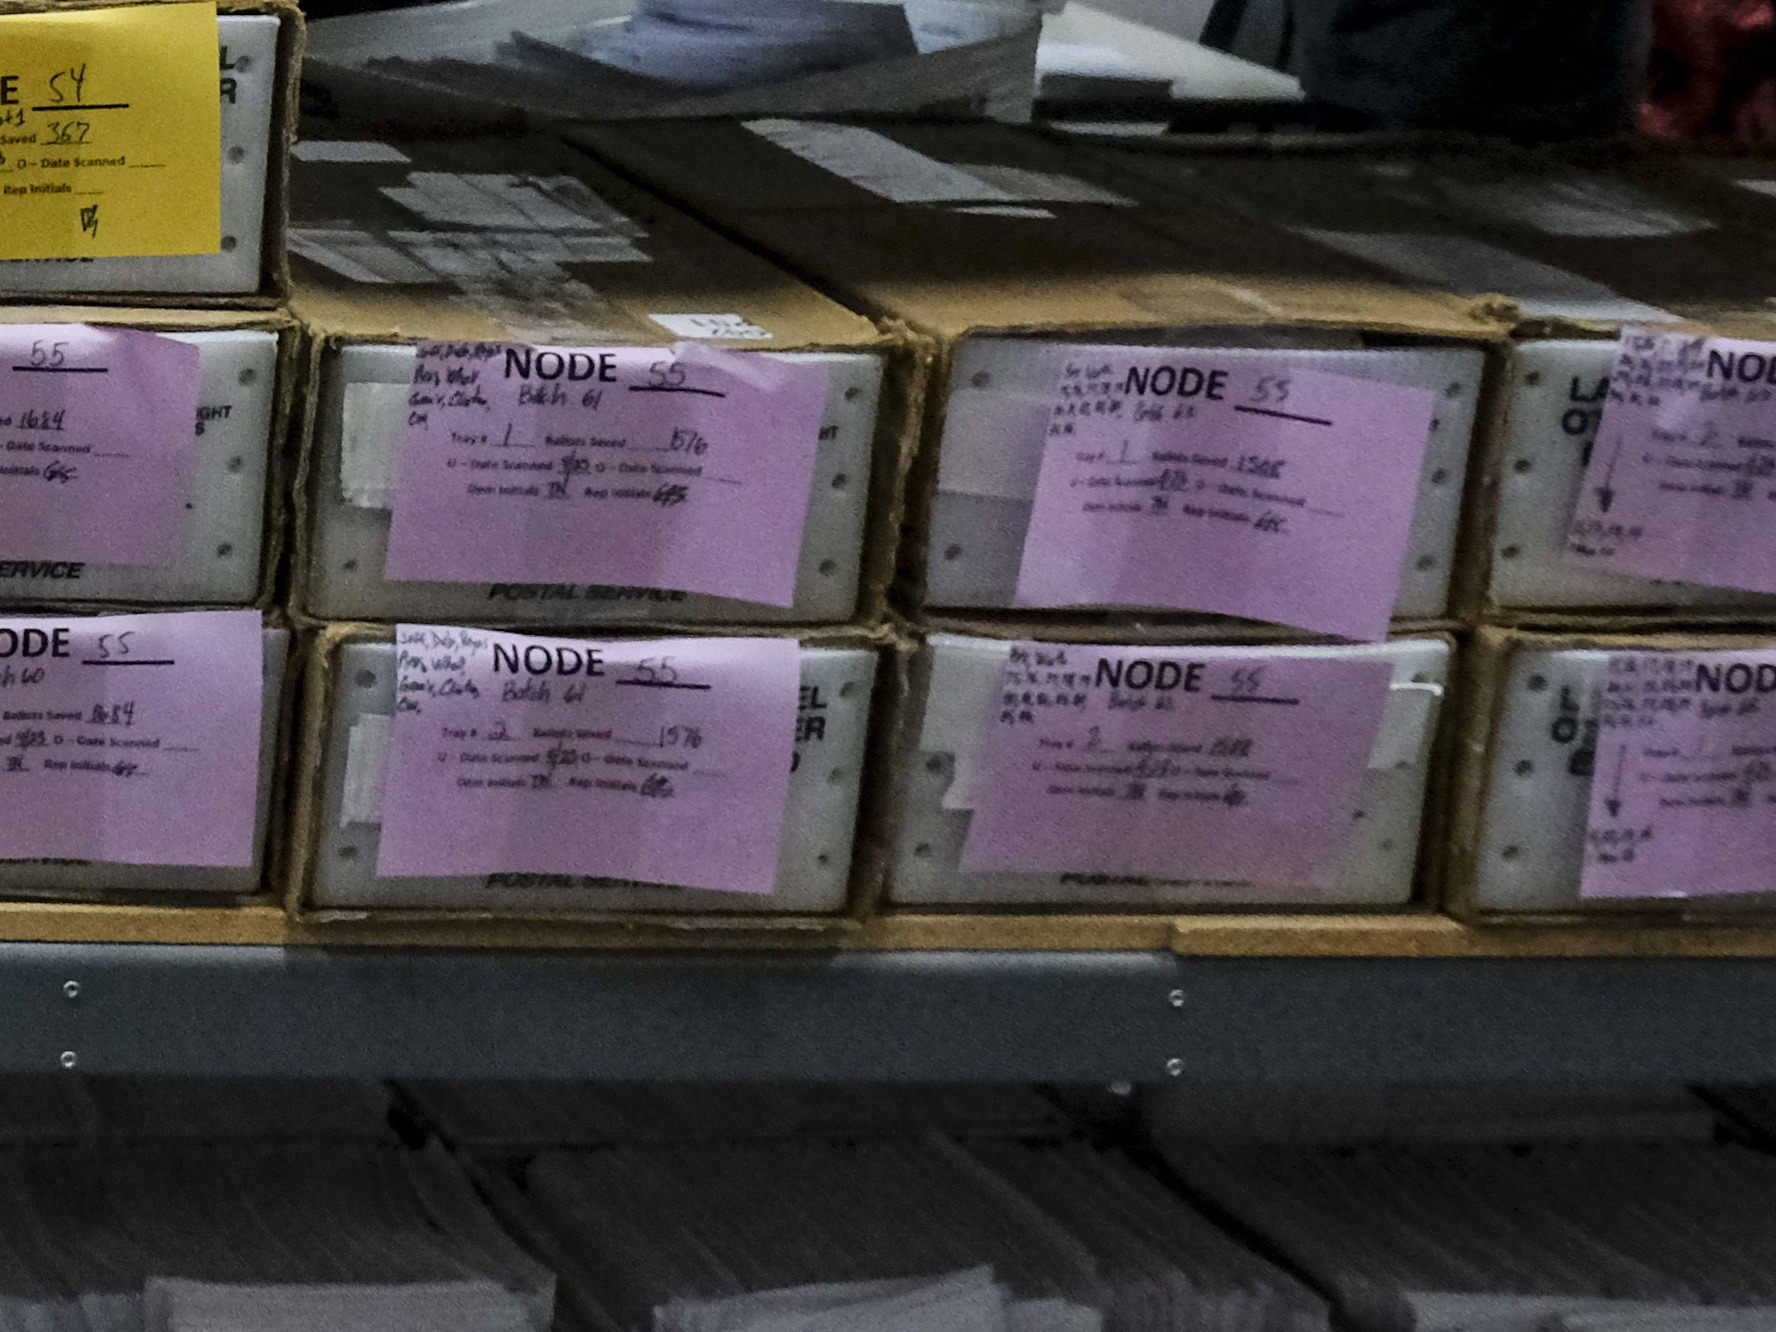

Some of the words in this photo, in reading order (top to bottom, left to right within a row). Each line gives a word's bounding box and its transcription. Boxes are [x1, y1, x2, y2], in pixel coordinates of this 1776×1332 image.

[29, 340, 69, 367] 55
[1125, 367, 1228, 400] NODE
[98, 635, 134, 661] 55
[497, 645, 604, 676] NODE
